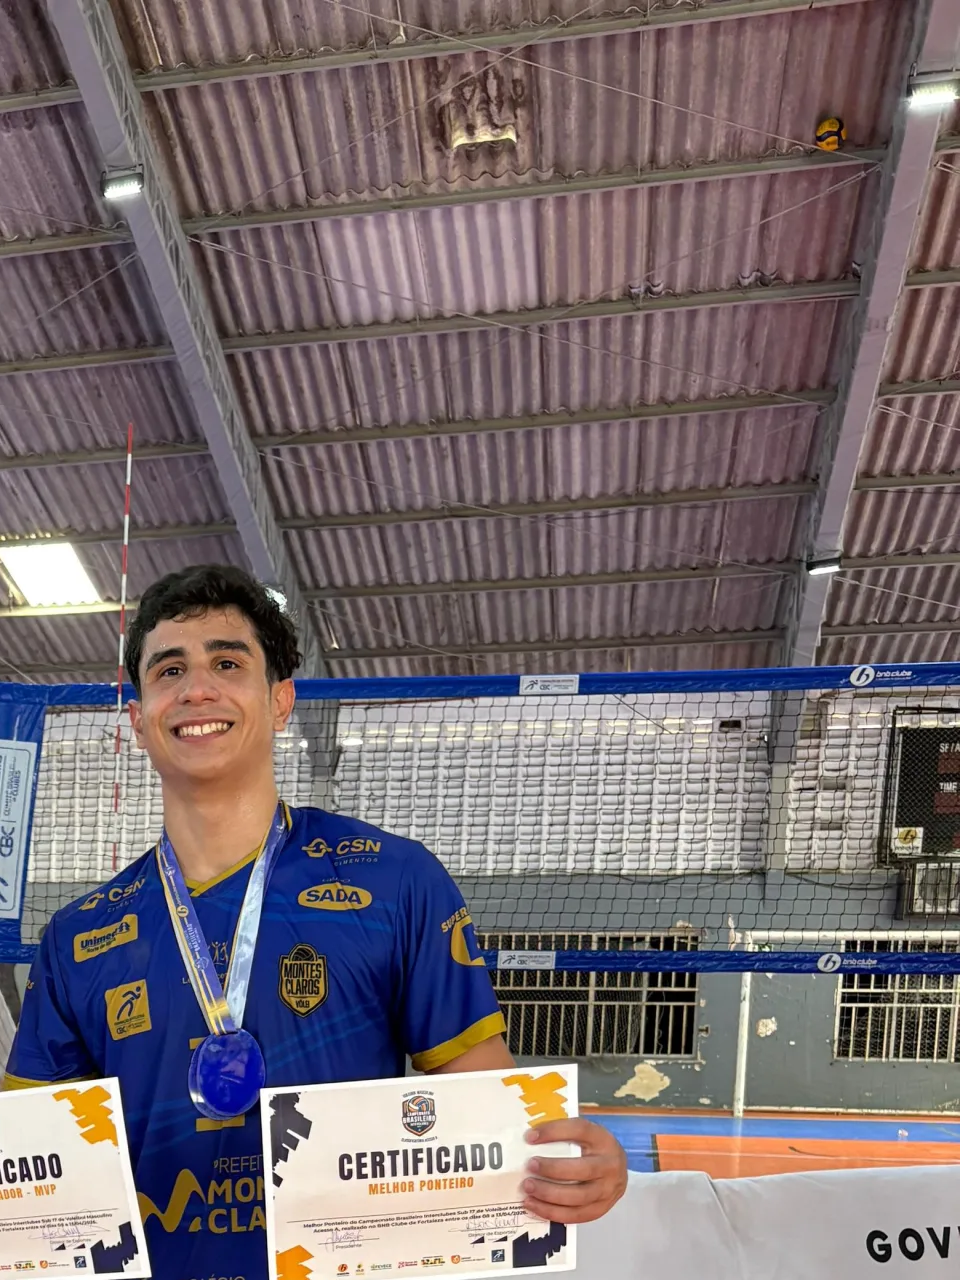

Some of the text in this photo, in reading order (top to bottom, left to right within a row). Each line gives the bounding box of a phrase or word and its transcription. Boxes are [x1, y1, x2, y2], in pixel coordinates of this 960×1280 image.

[336, 839, 382, 855] CSN
[334, 857, 379, 867] CIMENTOS
[305, 888, 362, 905] SADA
[80, 927, 118, 949] Unimed
[284, 963, 322, 979] MONTES
[285, 979, 320, 995] CLAROS
[403, 1115, 436, 1124] BRASILEIRO
[338, 1142, 503, 1181] CERTIFICADO
[34, 1183, 57, 1198] MVP
[368, 1177, 475, 1196] MELHOR PONTEIRO
[358, 1217, 395, 1225] Campeonato
[417, 1217, 444, 1225] Fortaleza
[865, 1226, 960, 1263] GOV
